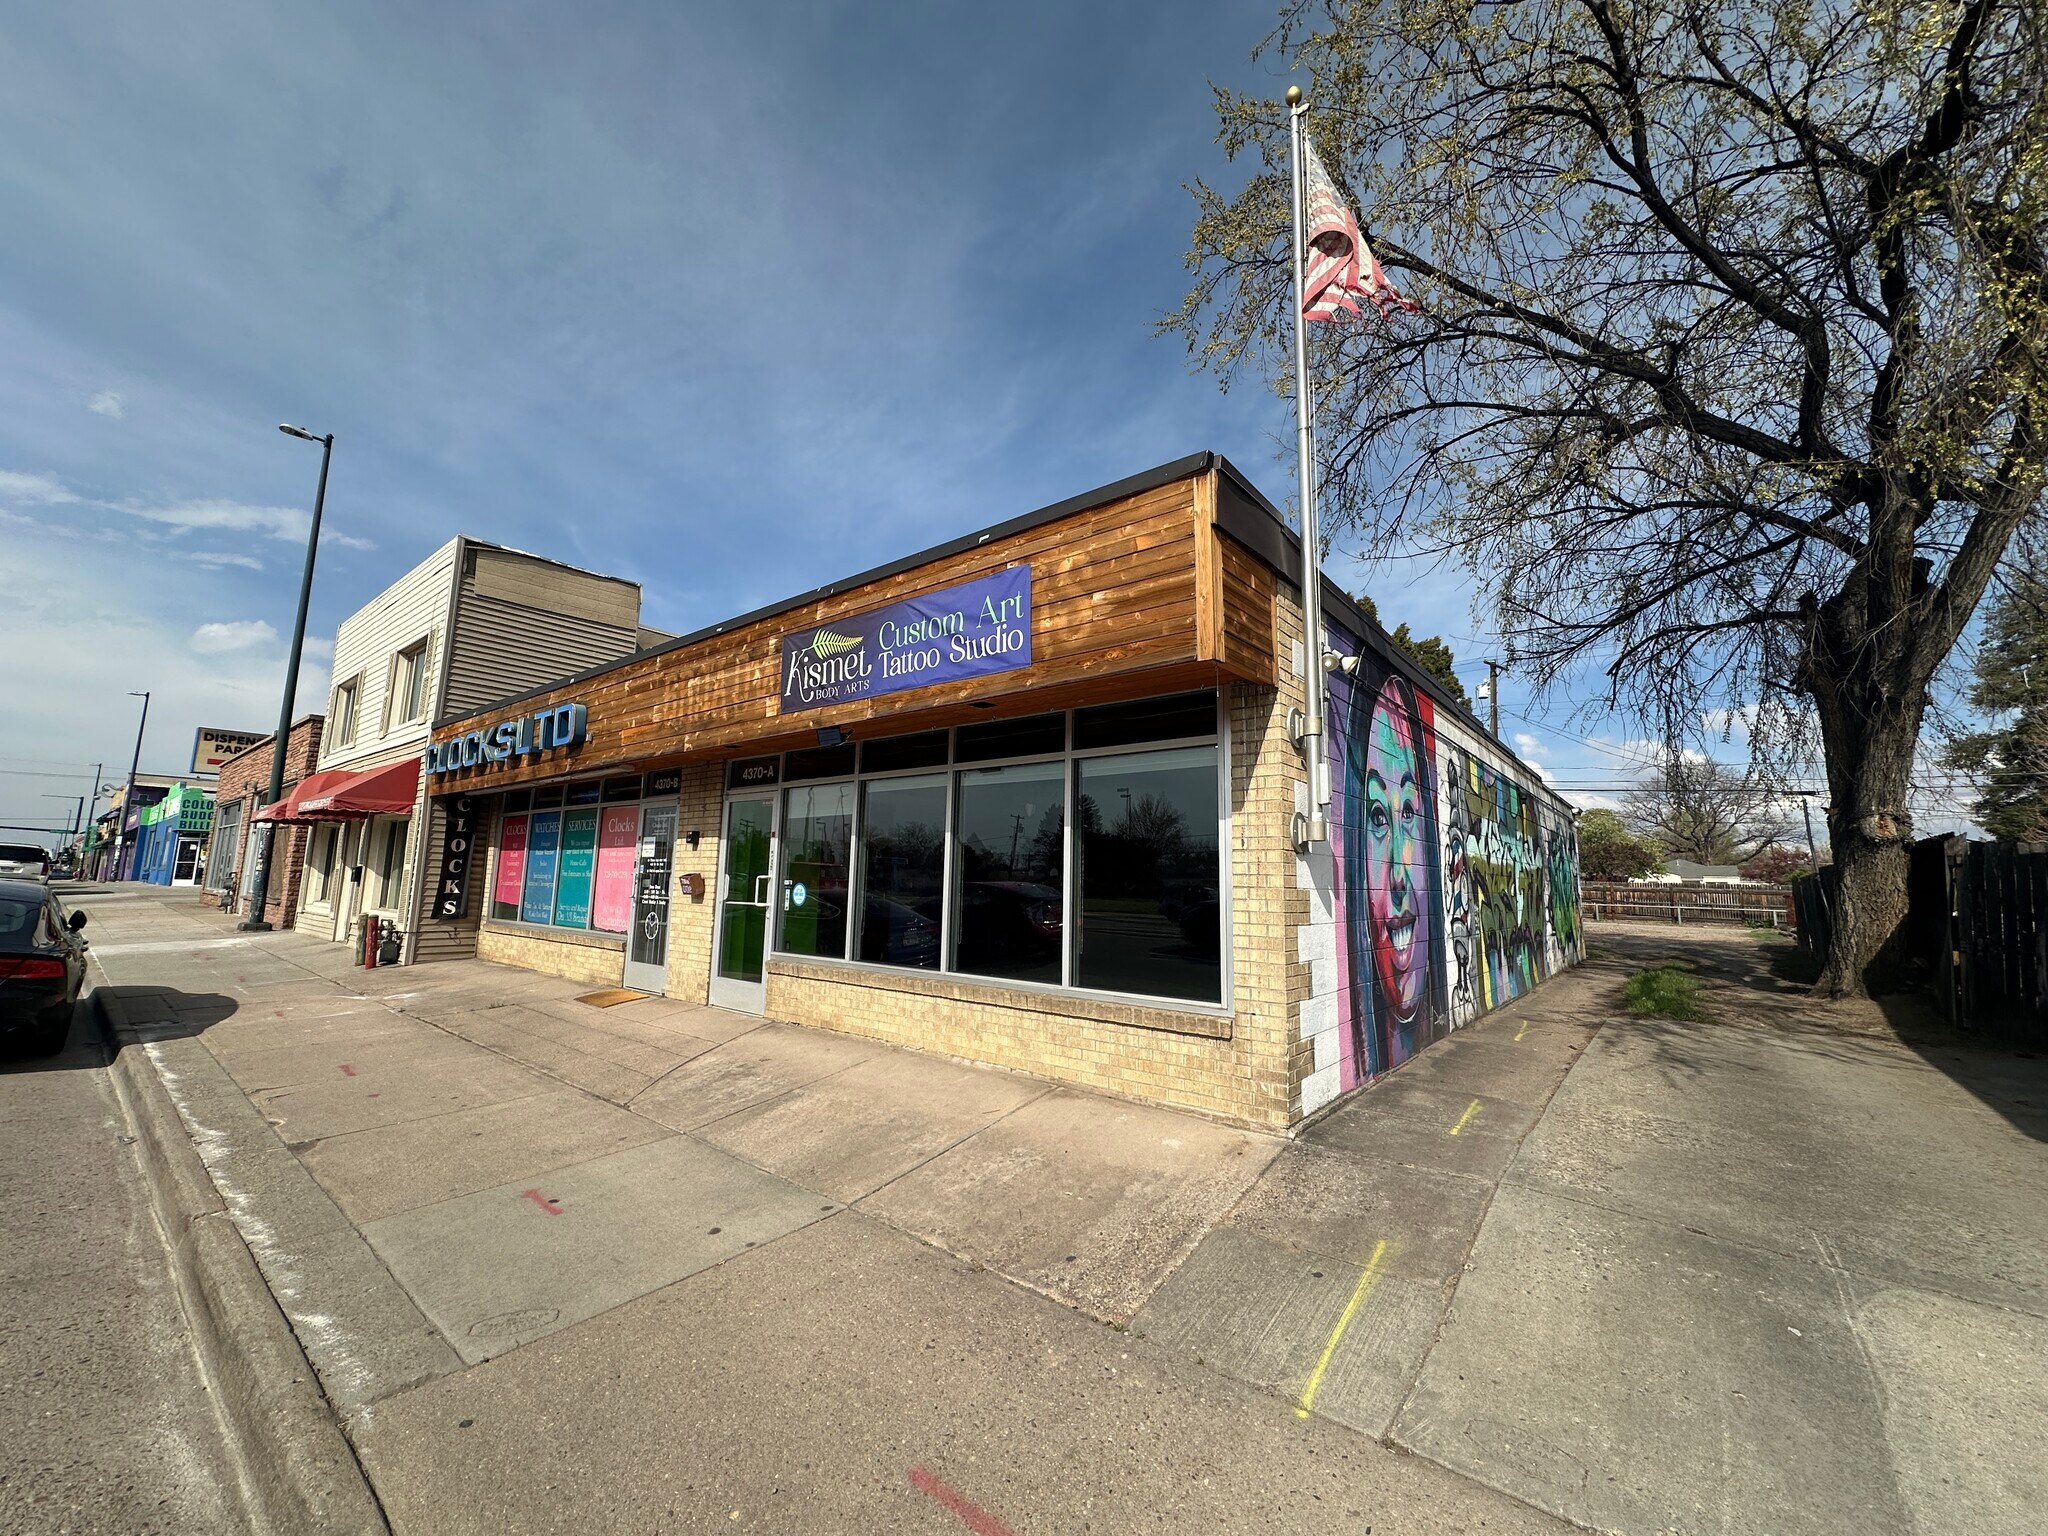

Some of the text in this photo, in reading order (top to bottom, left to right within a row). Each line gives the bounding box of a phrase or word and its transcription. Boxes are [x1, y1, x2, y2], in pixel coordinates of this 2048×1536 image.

[879, 590, 1024, 650] Custom Art
[878, 624, 1024, 678] Tattoo Studio
[784, 645, 872, 702] Kismet
[816, 679, 870, 700] BODY ARTS
[215, 744, 247, 754] PAR
[743, 766, 774, 780] 4370-A
[655, 777, 678, 790] 4370-B
[506, 824, 526, 835] CLOCKS
[535, 822, 560, 833] WATCHES
[568, 819, 596, 831] SERVICES
[608, 817, 635, 832] Clocks
[442, 799, 471, 915] CLOCKS
